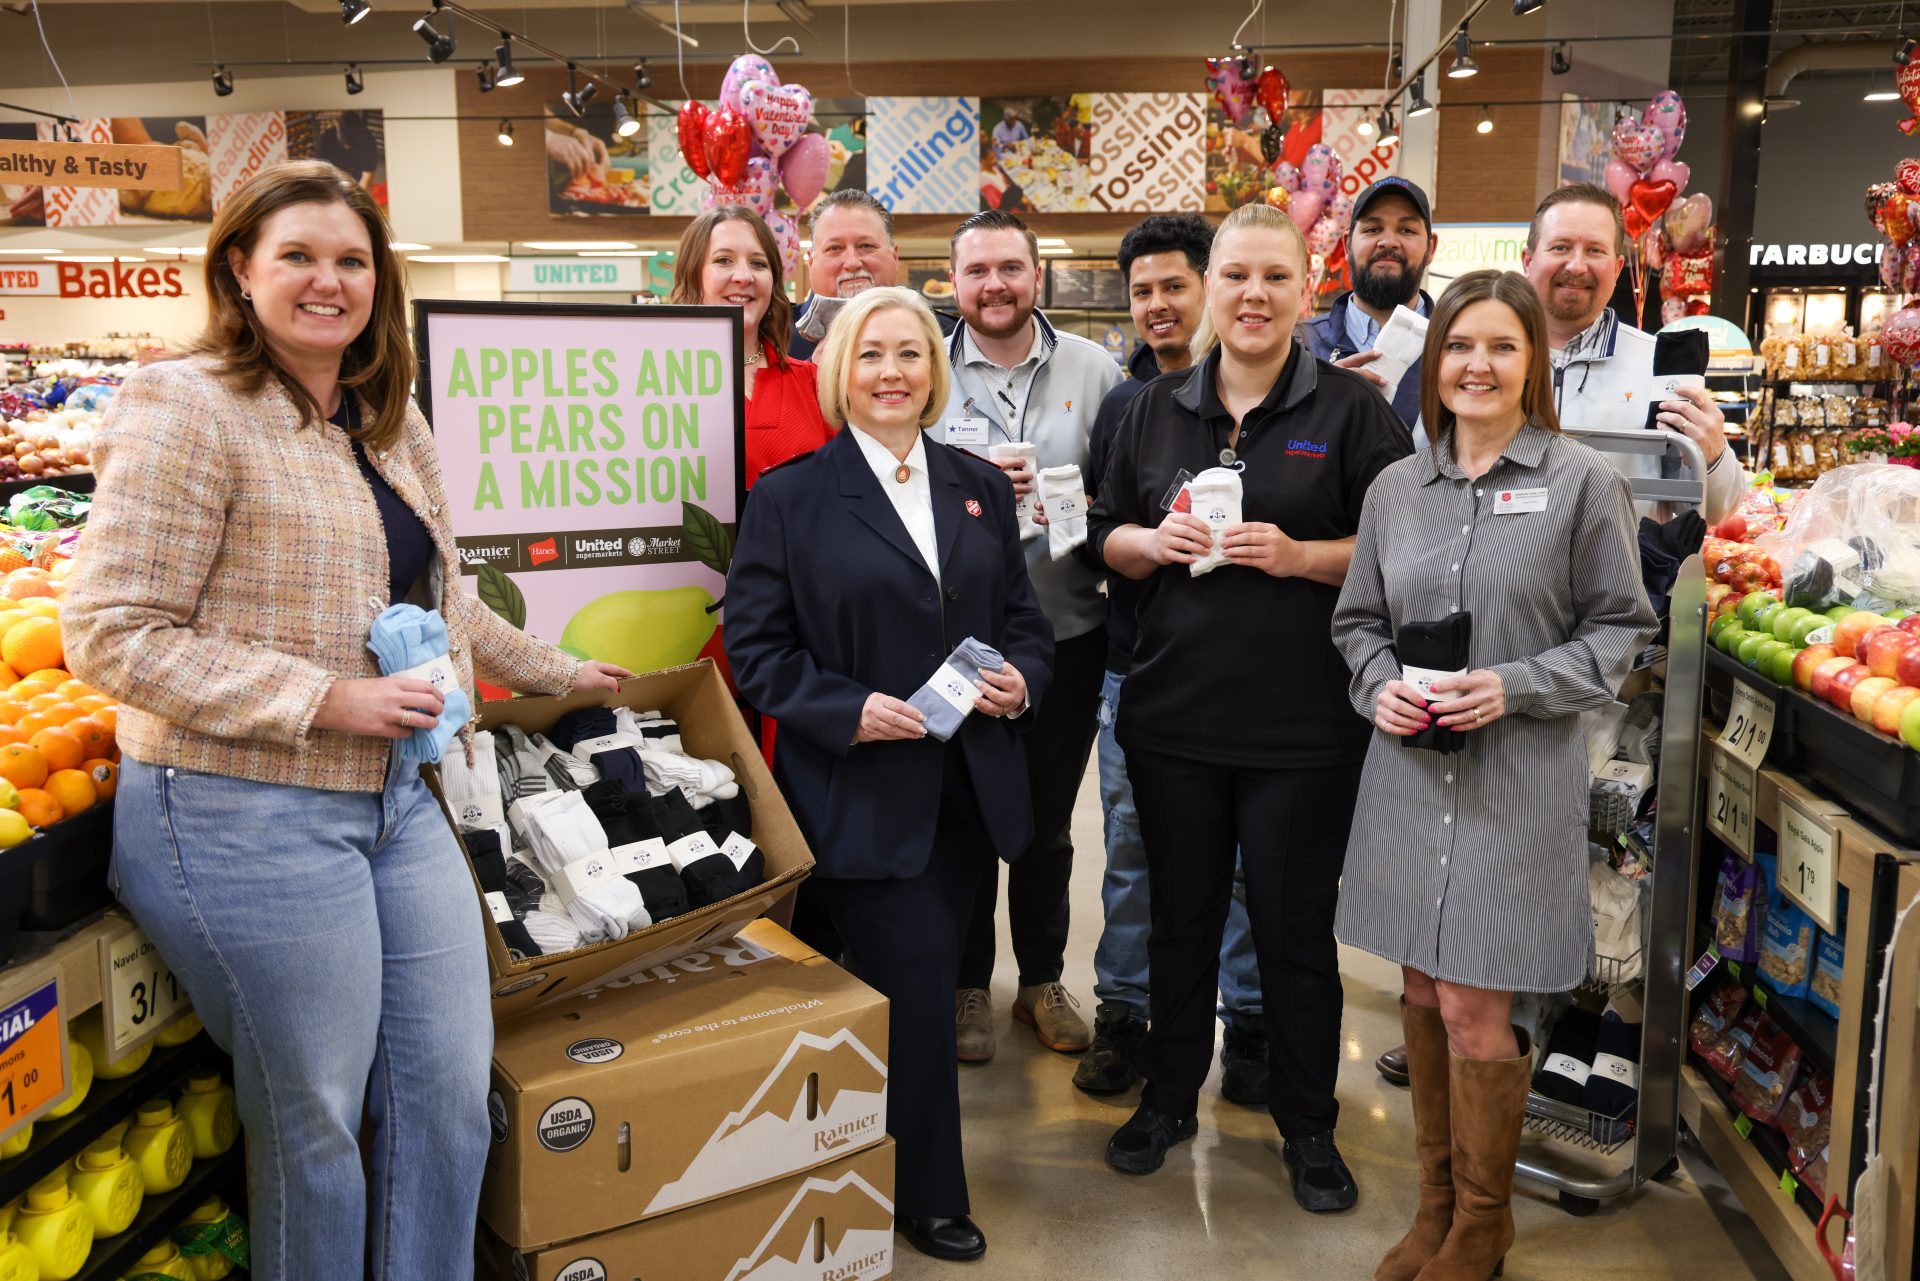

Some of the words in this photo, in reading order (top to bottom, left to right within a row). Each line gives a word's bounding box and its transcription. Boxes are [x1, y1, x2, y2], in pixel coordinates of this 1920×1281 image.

[64, 156, 79, 174] &
[85, 157, 147, 180] Tasty
[57, 258, 182, 298] Bakes
[534, 264, 618, 284] UNITED
[447, 348, 619, 398] APPLES
[635, 349, 723, 396] AND
[478, 403, 625, 454] PEARS
[642, 402, 700, 450] ON
[1287, 440, 1328, 452] United
[473, 461, 504, 511] A
[520, 456, 707, 509] MISSION
[575, 538, 623, 553] United
[647, 537, 682, 548] Market
[648, 546, 680, 555] STREET
[532, 547, 555, 556] Hanes
[575, 550, 623, 560] supermarkets
[1798, 861, 1805, 894] 1
[1806, 867, 1815, 884] 79
[114, 948, 138, 971] Navel
[739, 999, 824, 1023] Wholesome
[694, 1022, 719, 1032] the
[721, 1018, 737, 1026] to
[573, 1041, 611, 1054] ORGANIC
[582, 1048, 615, 1060] USDA
[1, 1080, 15, 1116] 1
[23, 1068, 38, 1088] 00
[550, 1108, 583, 1125] USDA
[547, 1123, 587, 1139] ORGANIC
[814, 1112, 879, 1152] Rainier
